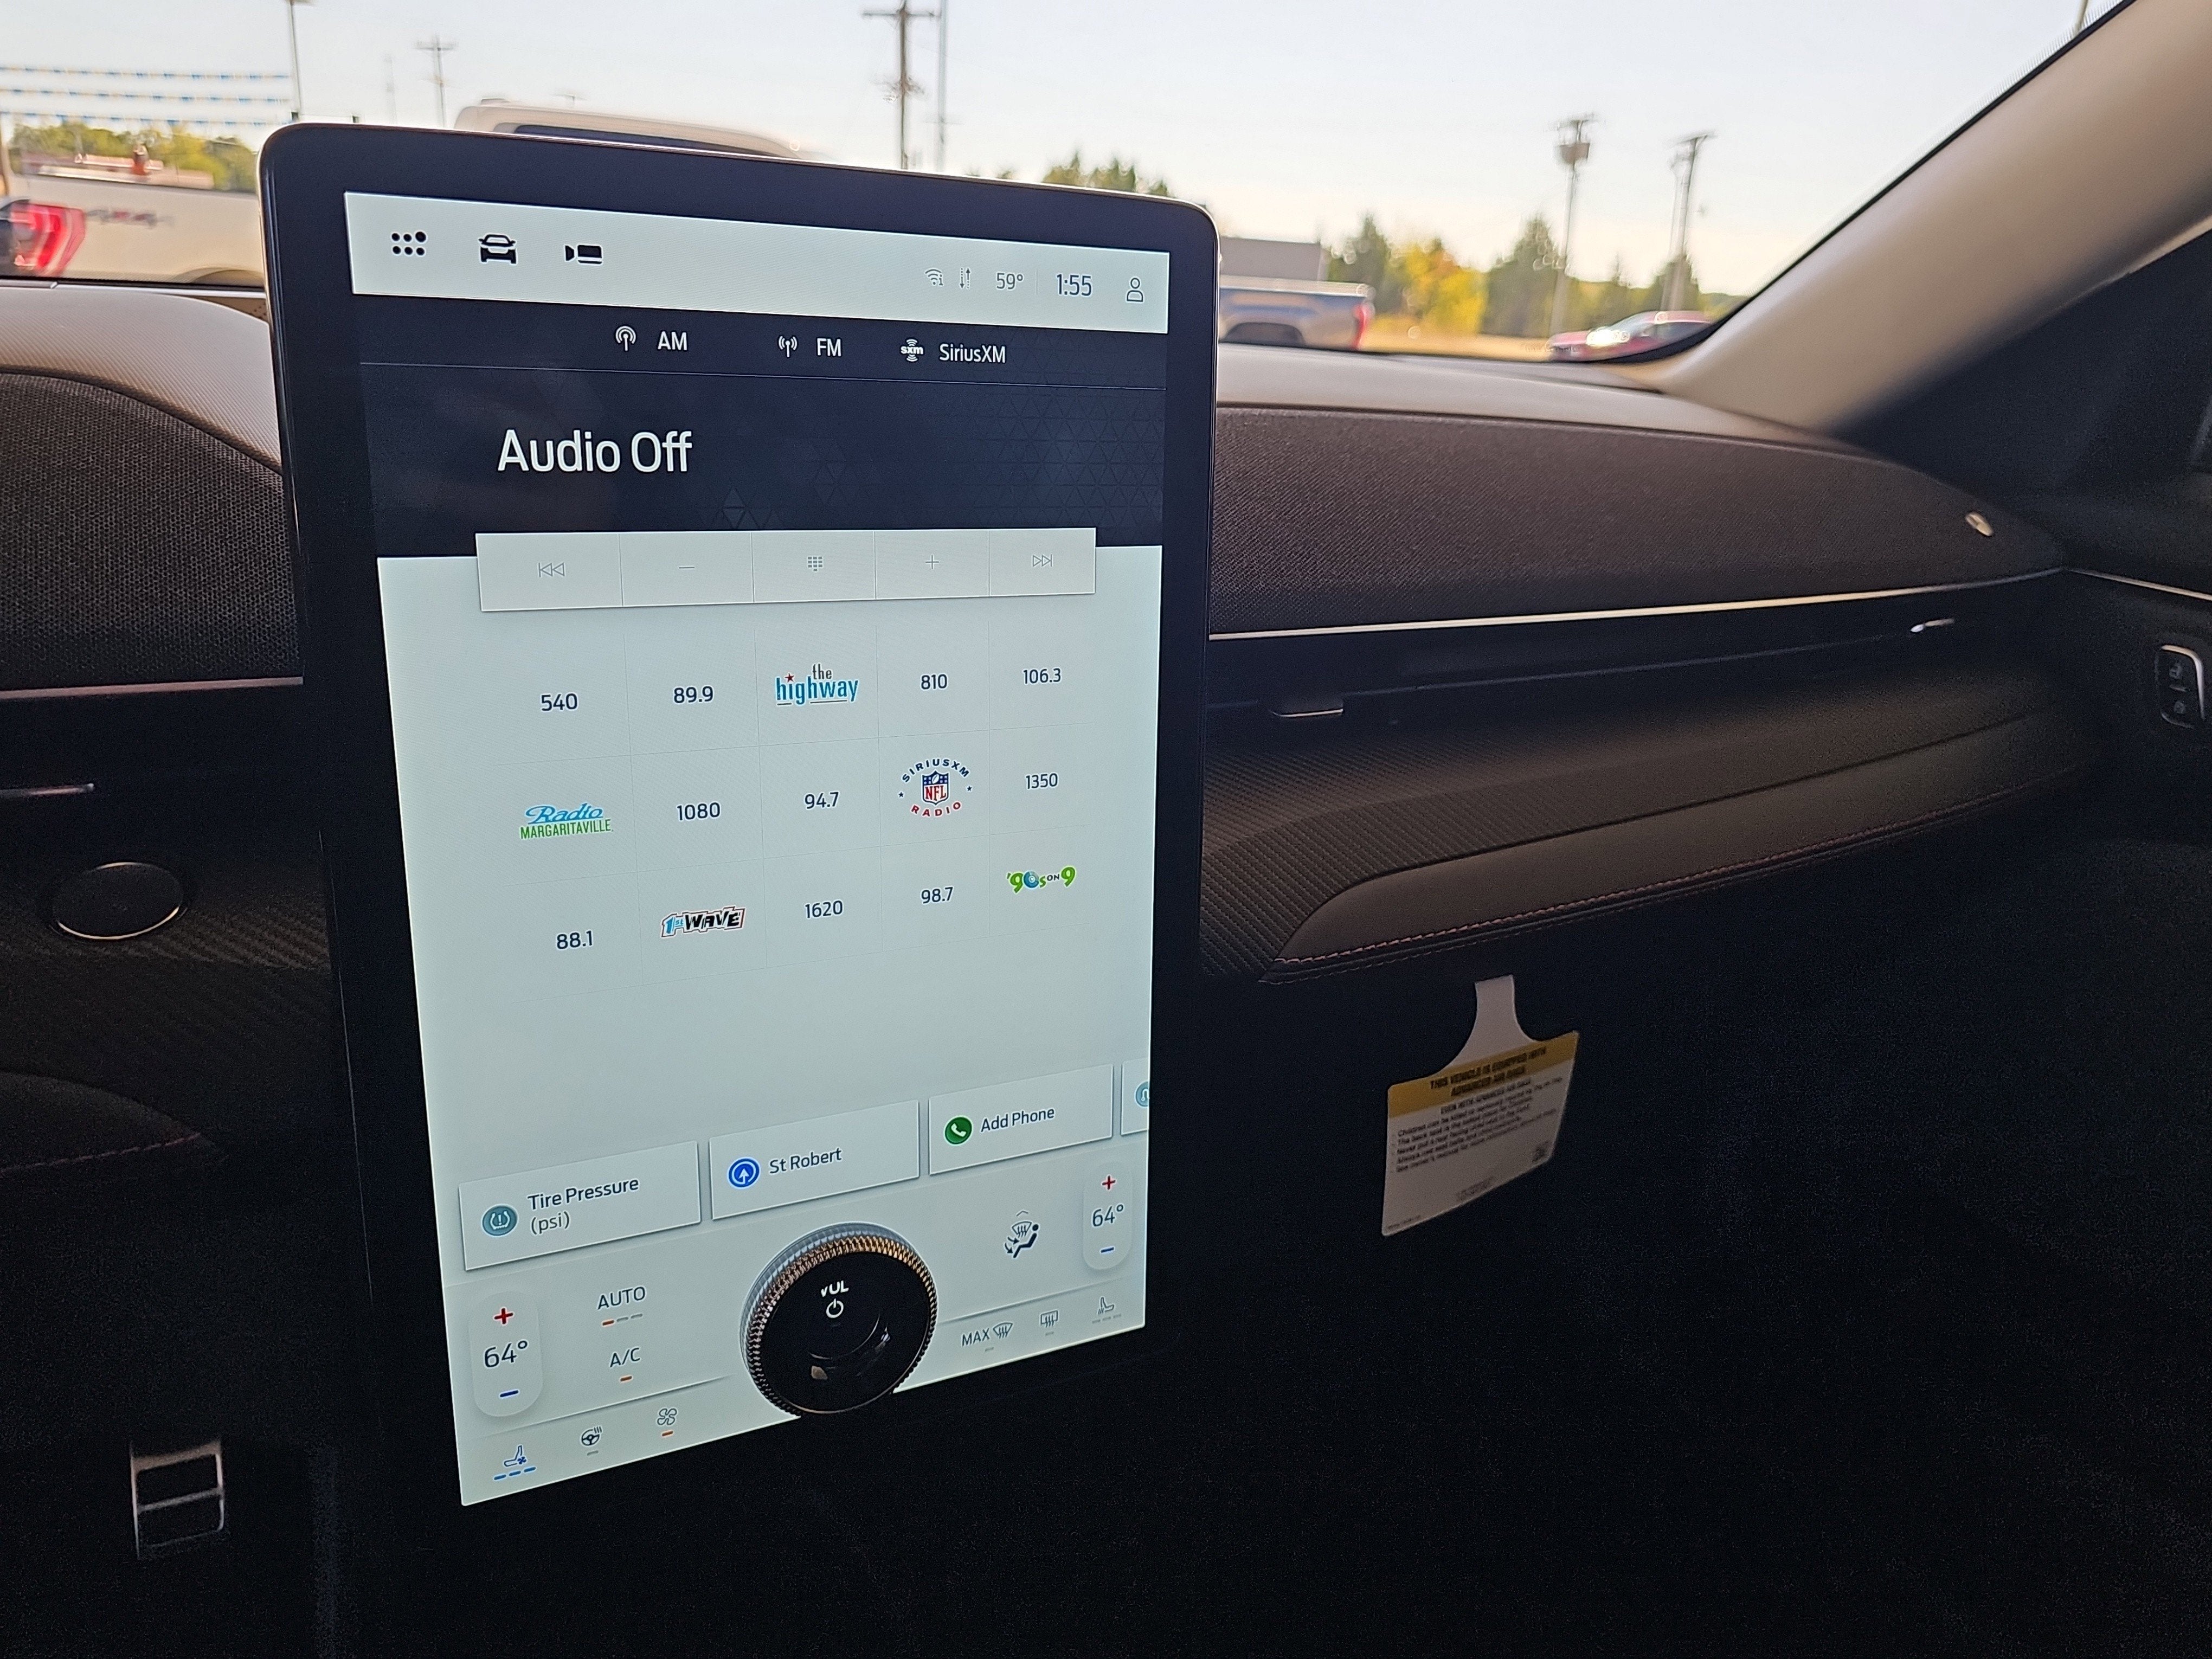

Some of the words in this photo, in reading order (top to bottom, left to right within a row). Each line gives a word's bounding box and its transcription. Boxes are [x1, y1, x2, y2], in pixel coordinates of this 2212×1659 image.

[996, 272, 1023, 290] 59°
[1057, 274, 1092, 297] 1:55
[657, 331, 687, 351] AM
[816, 338, 841, 357] FM
[901, 345, 924, 355] sxm
[939, 343, 1005, 363] SiriusXM
[498, 429, 620, 472] Audio
[631, 430, 692, 472] Off
[812, 663, 833, 679] the
[1023, 668, 1061, 684] 106.3
[776, 676, 859, 704] highway
[921, 673, 947, 690] 810
[541, 693, 578, 711] 540
[674, 686, 713, 704] 89.9
[901, 758, 970, 783] SIRIUSXM
[1026, 773, 1058, 789] 1350
[805, 792, 839, 809] 94.7
[925, 786, 947, 799] NFL
[525, 802, 604, 824] Radio
[677, 802, 721, 821] 1080
[911, 801, 962, 817] RADIO
[519, 819, 611, 840] MARGARITAVILLE
[1060, 866, 1076, 887] 9
[921, 886, 953, 904] 98.7
[805, 900, 843, 918] 1620
[666, 916, 684, 934] 1st
[685, 911, 741, 930] WAVE
[557, 930, 593, 950] 88.1
[981, 1114, 1008, 1133] Add
[1012, 1109, 1054, 1126] Phone
[769, 1158, 787, 1174] St
[790, 1147, 842, 1170] Robert
[527, 1193, 562, 1210] Tire
[565, 1179, 639, 1204] Pressure
[531, 1211, 570, 1235] (psi)
[1092, 1204, 1124, 1227] 64°
[597, 1286, 646, 1310] AUTO
[962, 1327, 990, 1347] MAX
[484, 1340, 528, 1368] 64°
[609, 1347, 640, 1368] A/C
